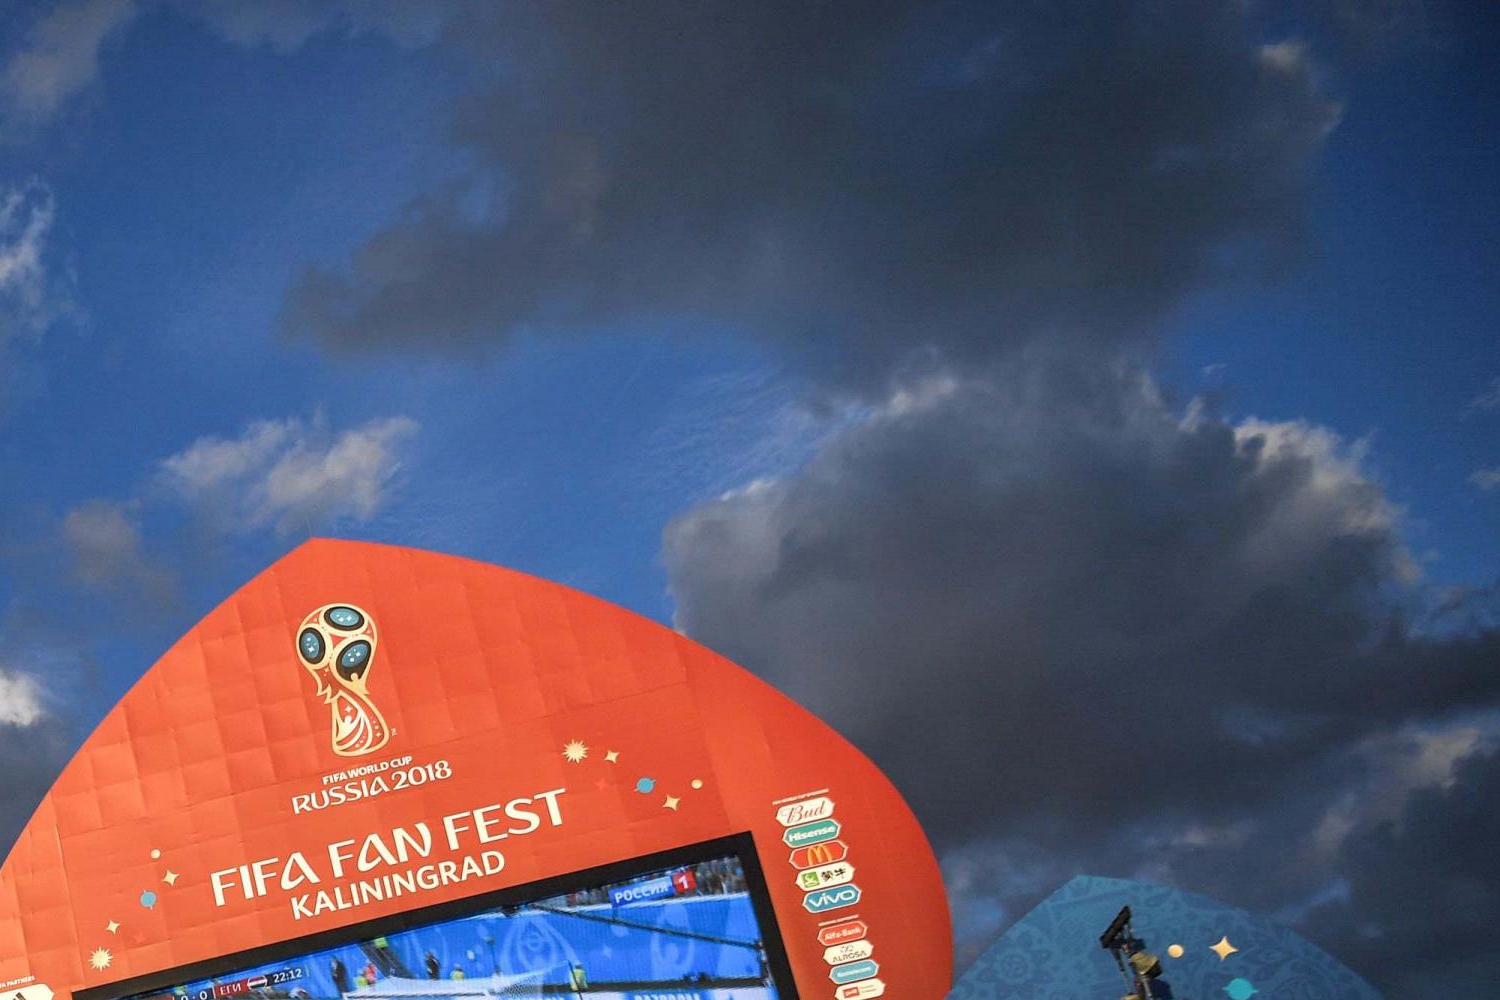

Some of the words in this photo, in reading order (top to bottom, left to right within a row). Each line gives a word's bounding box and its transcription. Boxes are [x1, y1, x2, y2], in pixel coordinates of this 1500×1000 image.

[322, 772, 349, 786] FIFA
[347, 761, 389, 779] WORLD
[390, 755, 413, 769] CUP
[291, 776, 390, 815] RUSSIA
[391, 760, 452, 790] 2018
[781, 800, 825, 824] Bud
[788, 826, 836, 842] Hisense
[210, 851, 322, 907] FIFA
[328, 822, 432, 878] FAN
[443, 788, 567, 851] FEST
[290, 850, 506, 921] KALININGRAD
[809, 890, 855, 907] vivo
[824, 927, 861, 941] Alfa-Bank
[832, 950, 867, 963] ALROSA
[273, 969, 303, 984] 22:12
